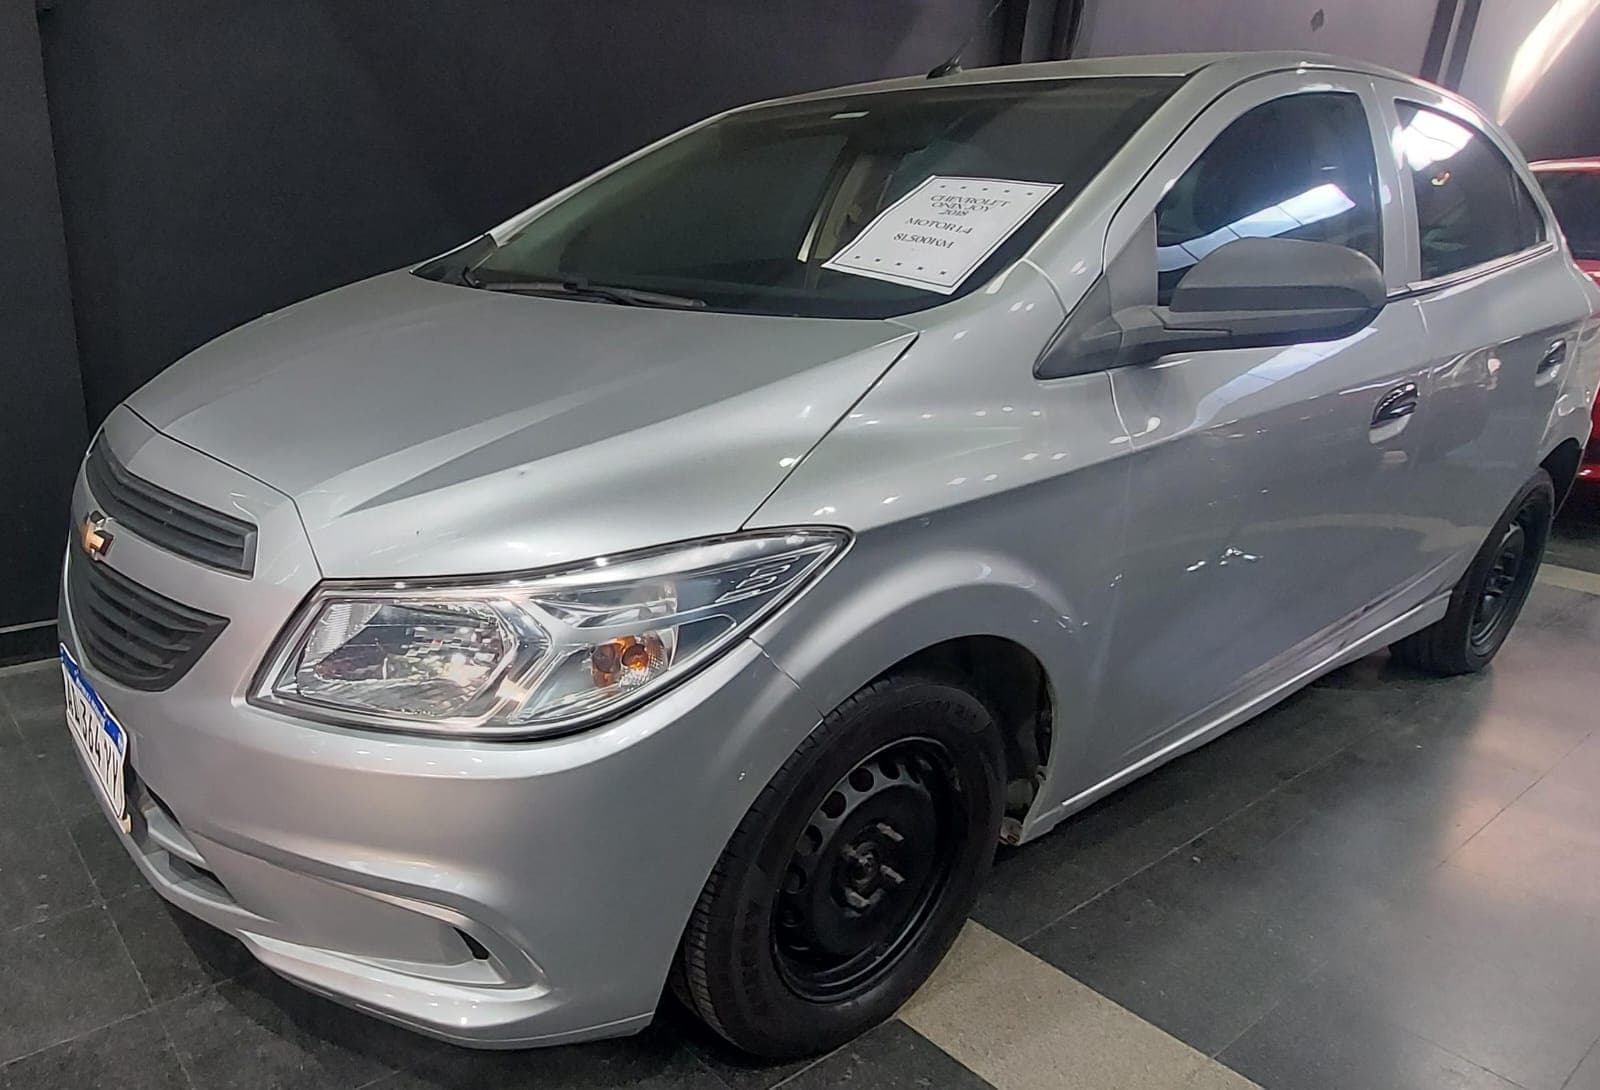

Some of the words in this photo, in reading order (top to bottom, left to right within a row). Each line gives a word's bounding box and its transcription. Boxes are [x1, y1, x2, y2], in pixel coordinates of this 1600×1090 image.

[930, 194, 1011, 208] CHEVROLET
[931, 202, 962, 210] ONIX
[964, 204, 989, 213] JOY
[937, 209, 970, 217] 2018
[905, 217, 957, 232] MOTOR
